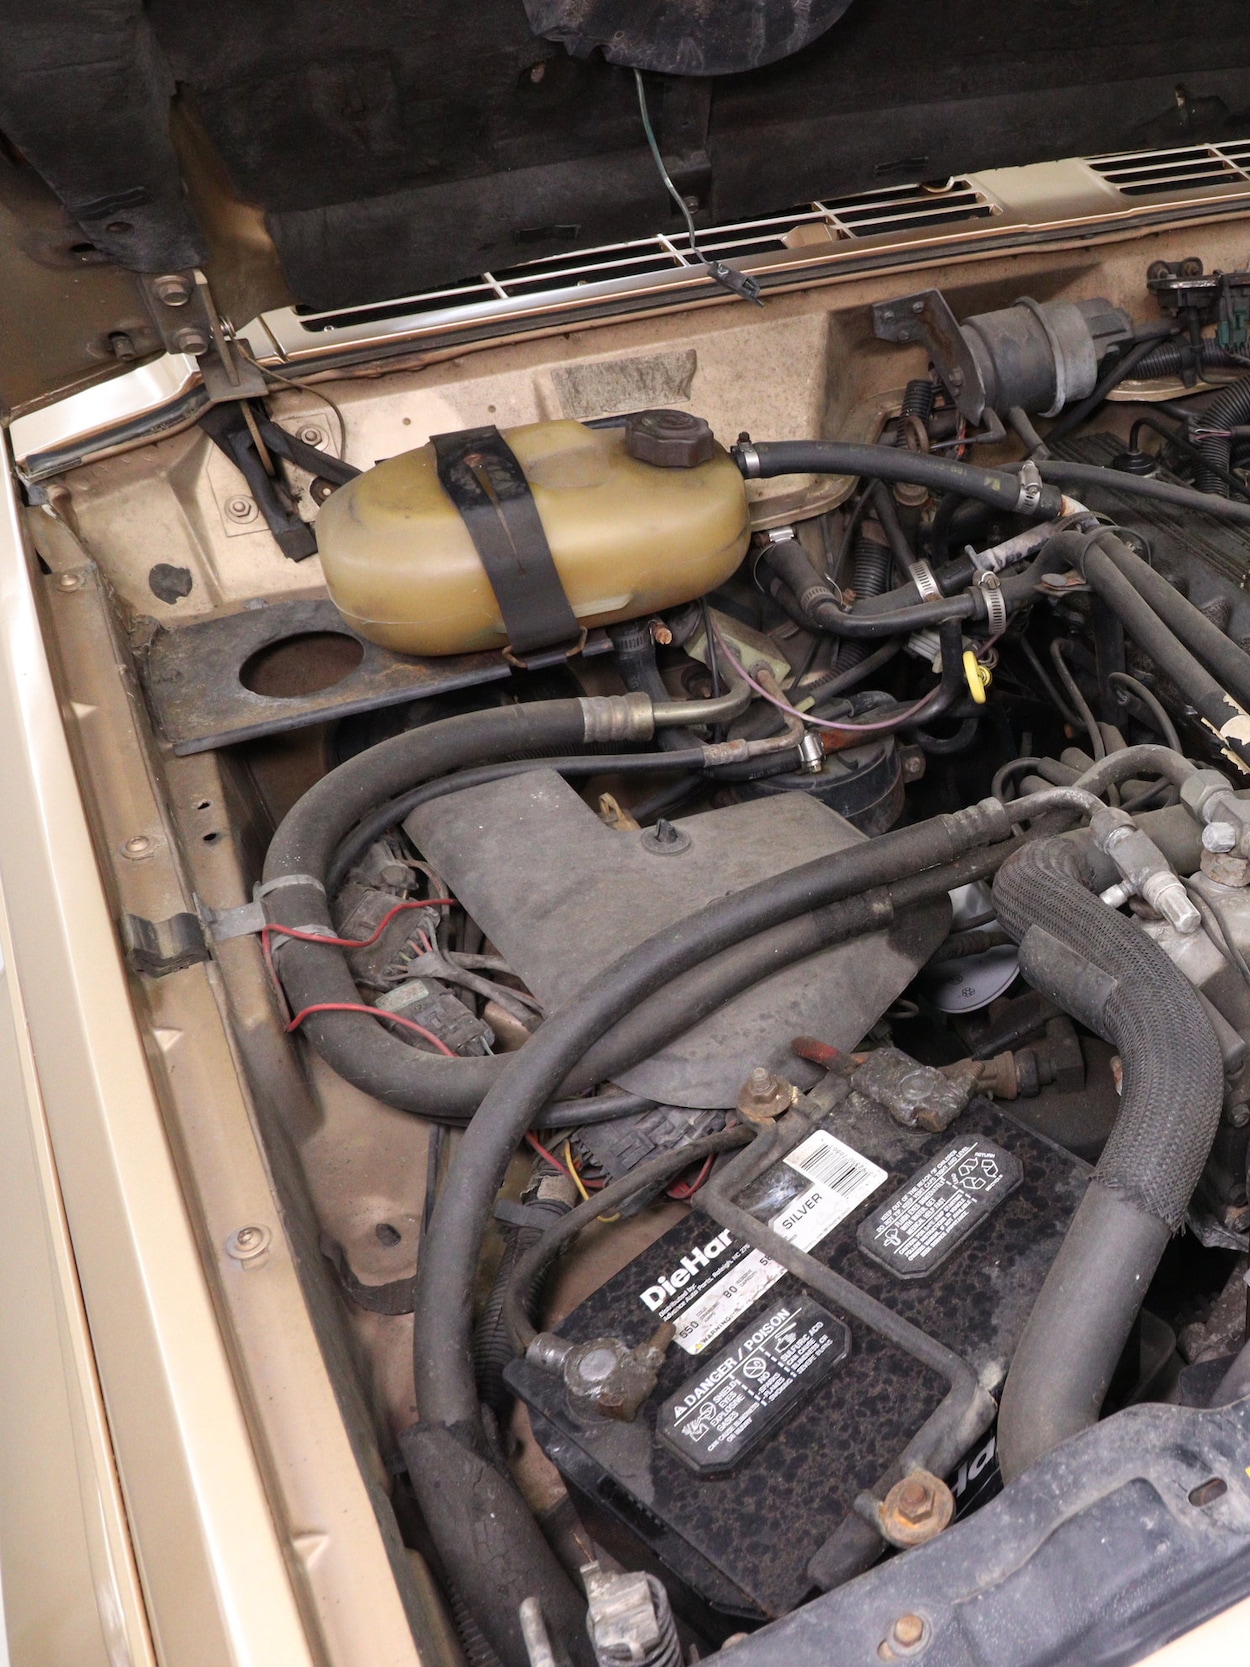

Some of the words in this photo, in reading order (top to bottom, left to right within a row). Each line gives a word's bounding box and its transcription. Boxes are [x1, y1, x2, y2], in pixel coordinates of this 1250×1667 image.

[880, 1209, 893, 1221] KEEP
[891, 1200, 903, 1210] OUT
[901, 1194, 909, 1202] OF
[908, 1185, 918, 1195] THE
[930, 1167, 938, 1175] OF
[925, 1197, 936, 1207] GET
[781, 1191, 822, 1230] SILVER
[876, 1224, 885, 1232] DO
[901, 1197, 914, 1209] KEEP
[907, 1202, 921, 1215] EYES
[923, 1206, 936, 1219] HELP
[933, 1196, 946, 1209] FAST
[639, 1228, 733, 1311] DieHar
[759, 1253, 772, 1266] 58
[662, 1299, 687, 1323] Advance
[684, 1288, 699, 1303] Auto
[732, 1251, 742, 1260] NC
[723, 1284, 738, 1298] 80
[657, 1289, 689, 1318] Distributed
[779, 1333, 811, 1362] SULFURIC
[807, 1320, 824, 1336] ACID
[683, 1356, 738, 1406] DANGER
[743, 1307, 791, 1351] POISON
[785, 1353, 799, 1365] CAN
[756, 1371, 771, 1384] NO
[711, 1380, 738, 1403] SHIELD
[718, 1390, 737, 1408] EYES
[709, 1393, 746, 1426] EXPLOSIVE
[715, 1410, 739, 1432] GASES
